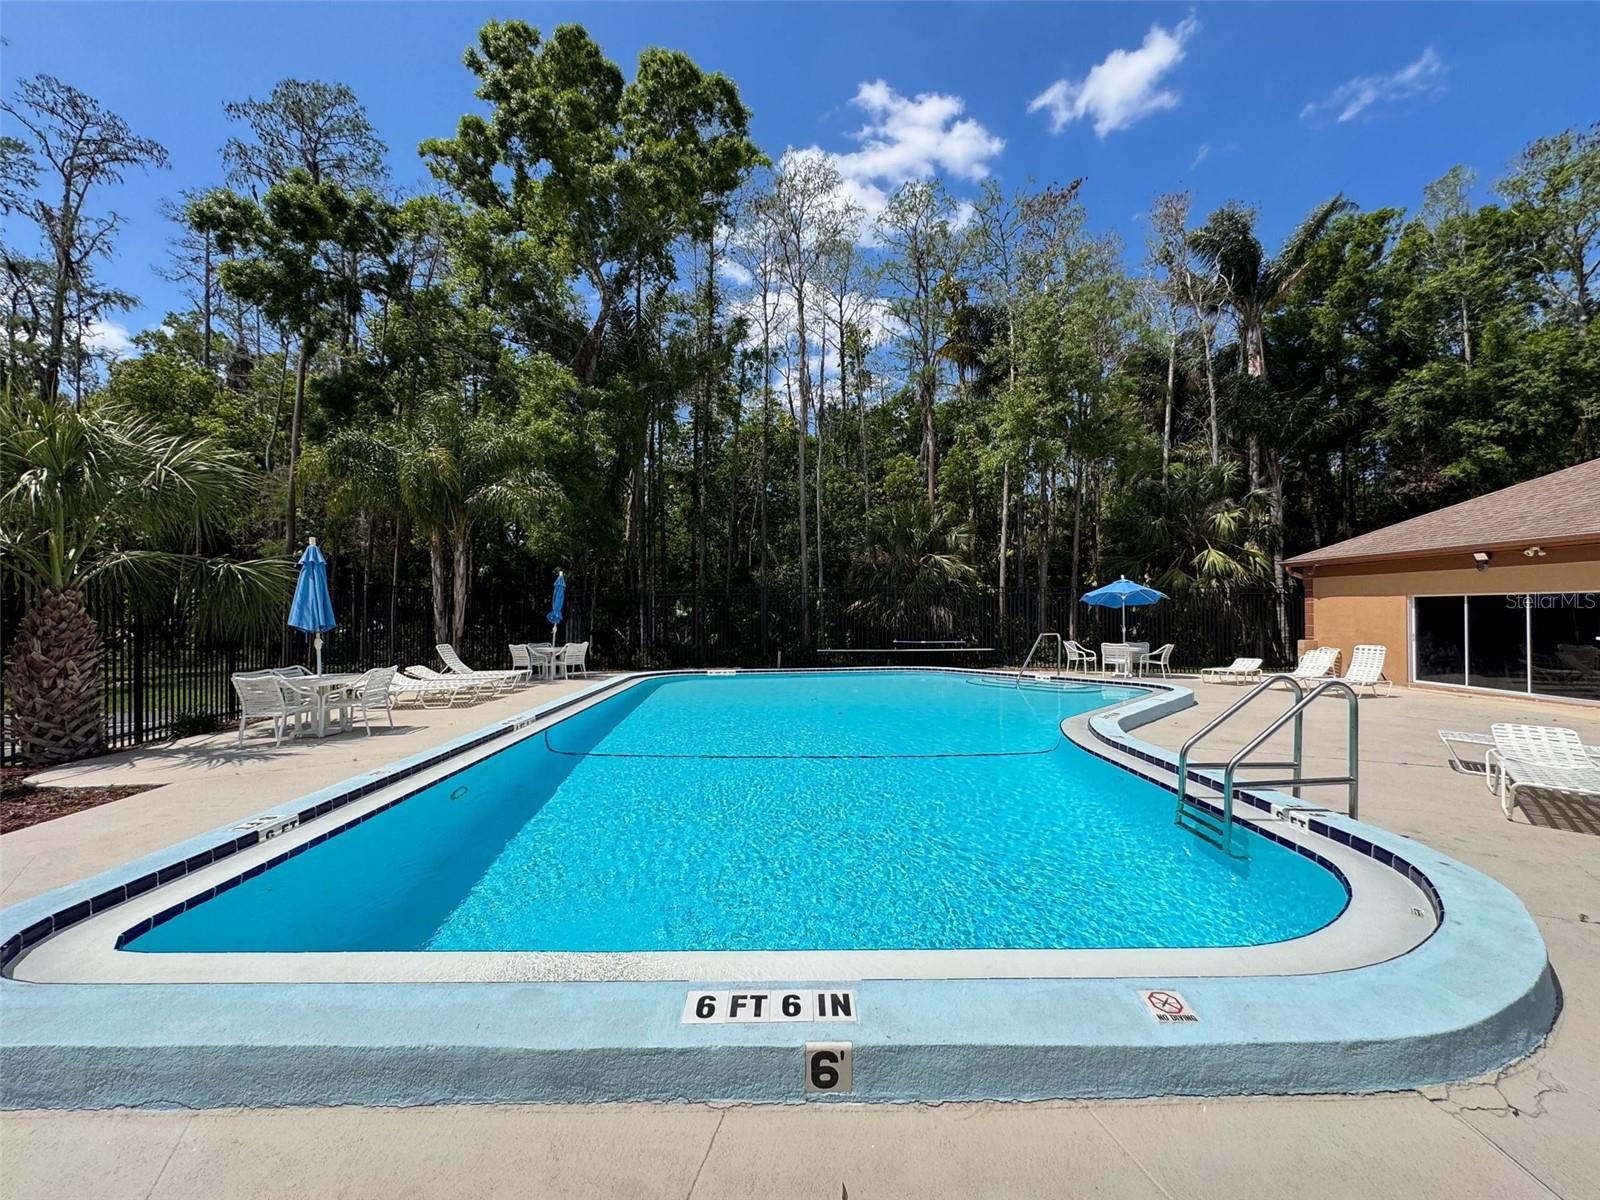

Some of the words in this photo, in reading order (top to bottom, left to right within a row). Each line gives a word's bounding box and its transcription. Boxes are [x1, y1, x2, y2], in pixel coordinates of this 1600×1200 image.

[695, 994, 717, 1019] 6
[729, 994, 768, 1018] FT
[781, 994, 802, 1018] 6
[817, 993, 852, 1017] IN
[1169, 1014, 1199, 1022] DIVING
